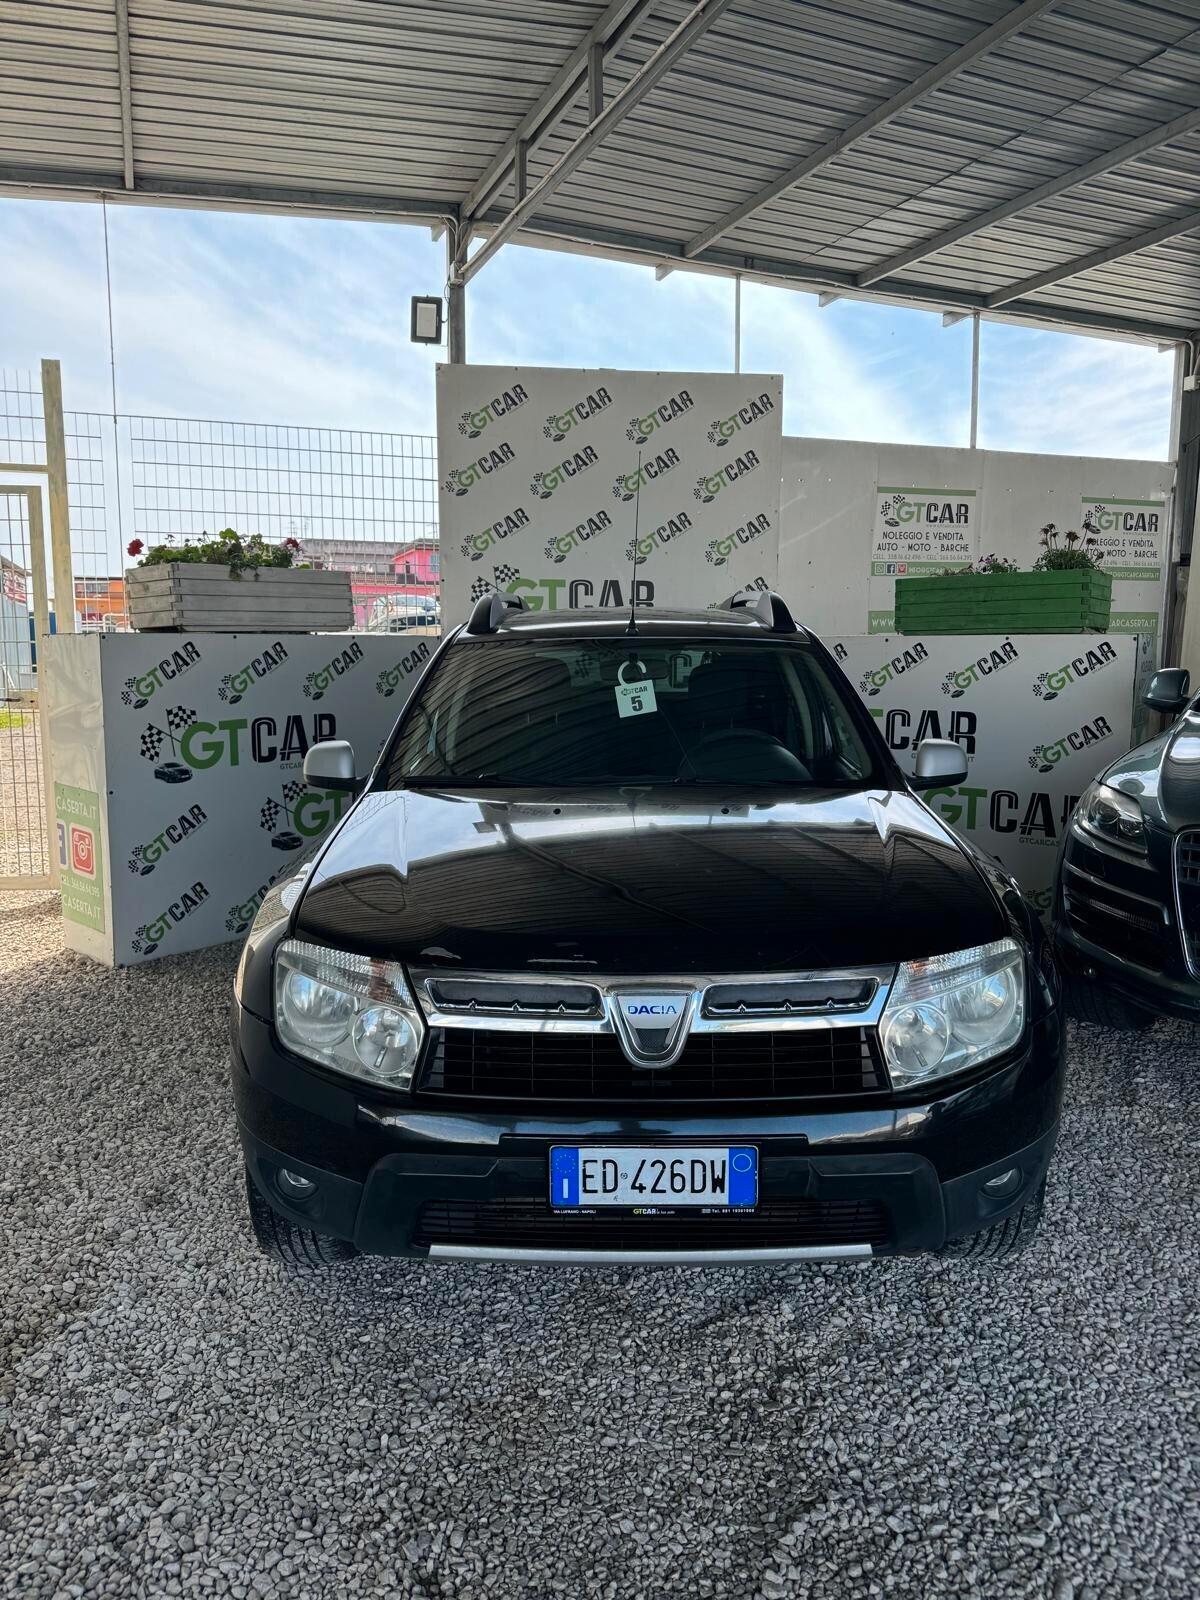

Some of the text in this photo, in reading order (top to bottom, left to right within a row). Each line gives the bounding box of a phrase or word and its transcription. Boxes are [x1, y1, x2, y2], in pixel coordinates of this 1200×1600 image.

[469, 384, 530, 431] GTCAR
[555, 387, 613, 434] GTCAR
[639, 390, 695, 436] GTCAR
[719, 393, 775, 438] GTCAR
[458, 441, 515, 488] GTCAR
[541, 445, 599, 492] GTCAR
[624, 447, 680, 493] GTCAR
[704, 449, 761, 496] GTCAR
[472, 507, 531, 554] GTCAR
[555, 510, 612, 556] GTCAR
[636, 512, 693, 556] GTCAR
[715, 513, 771, 557] GTCAR
[882, 531, 964, 541] NOLEGGIO E VENDITA
[897, 502, 969, 524] GTCAR
[1098, 512, 1158, 533] GTCAR
[877, 543, 899, 552] AUTO
[908, 543, 931, 552] MOTO
[941, 544, 969, 552] BARCHE
[1107, 549, 1127, 557] MOTO
[1134, 550, 1158, 558] BARCHE
[1129, 540, 1154, 548] VENDITA
[134, 640, 202, 699] GTCAR
[228, 640, 289, 695] GTCAR
[313, 641, 365, 691] GTCAR
[384, 641, 431, 689] GTCAR
[870, 642, 930, 688] GTCAR
[954, 641, 1019, 690] GTCAR
[1046, 641, 1118, 692] GTCAR
[630, 695, 643, 712] 5
[1042, 715, 1113, 766] GTCAR
[142, 804, 208, 864] GTCAR
[145, 881, 211, 943] GTCAR
[628, 1005, 677, 1015] DACIA
[582, 1159, 727, 1194] ED 426DW
